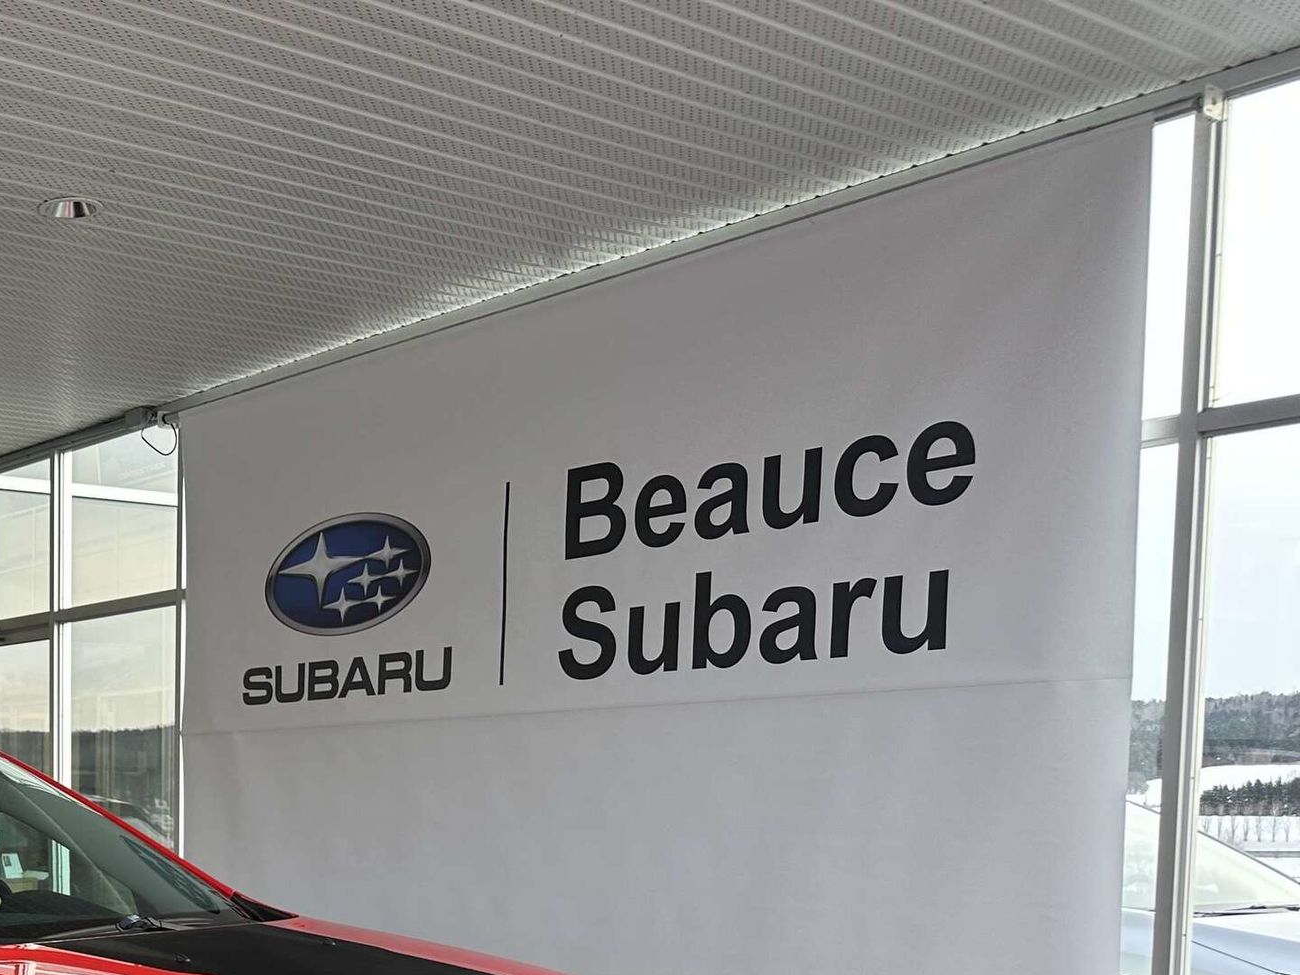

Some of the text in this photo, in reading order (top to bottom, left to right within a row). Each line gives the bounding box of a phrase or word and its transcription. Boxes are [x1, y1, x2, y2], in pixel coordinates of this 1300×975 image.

[564, 420, 976, 560] Beauce
[241, 647, 452, 706] SUBARU
[557, 568, 950, 681] Subaru
